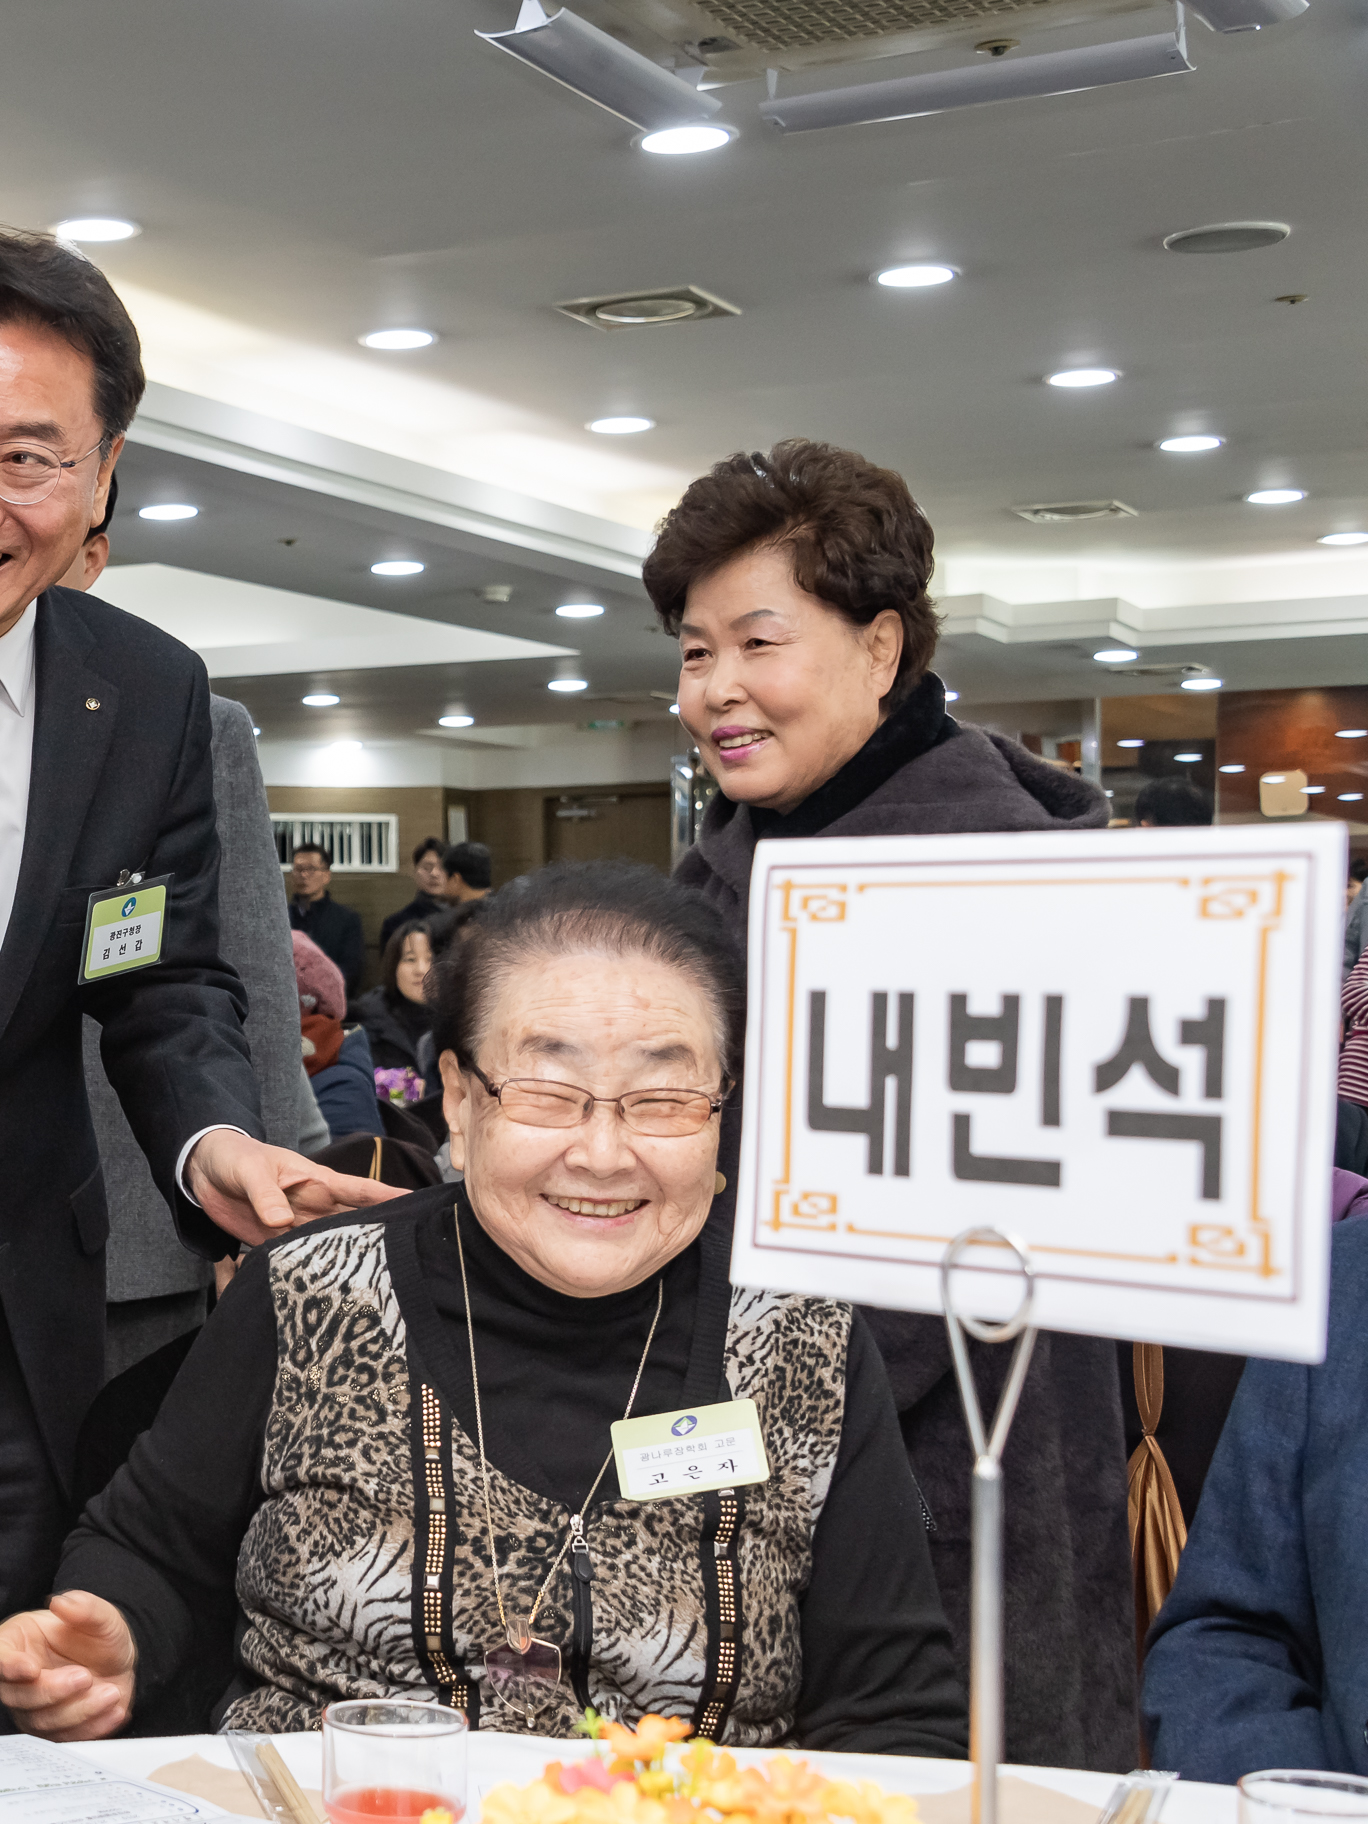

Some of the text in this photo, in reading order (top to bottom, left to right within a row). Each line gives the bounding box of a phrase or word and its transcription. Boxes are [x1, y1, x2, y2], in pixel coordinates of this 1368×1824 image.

[109, 924, 142, 941] 광진구청장
[806, 989, 1228, 1202] 내빈석
[639, 1436, 736, 1462] 광나루장학회 고문
